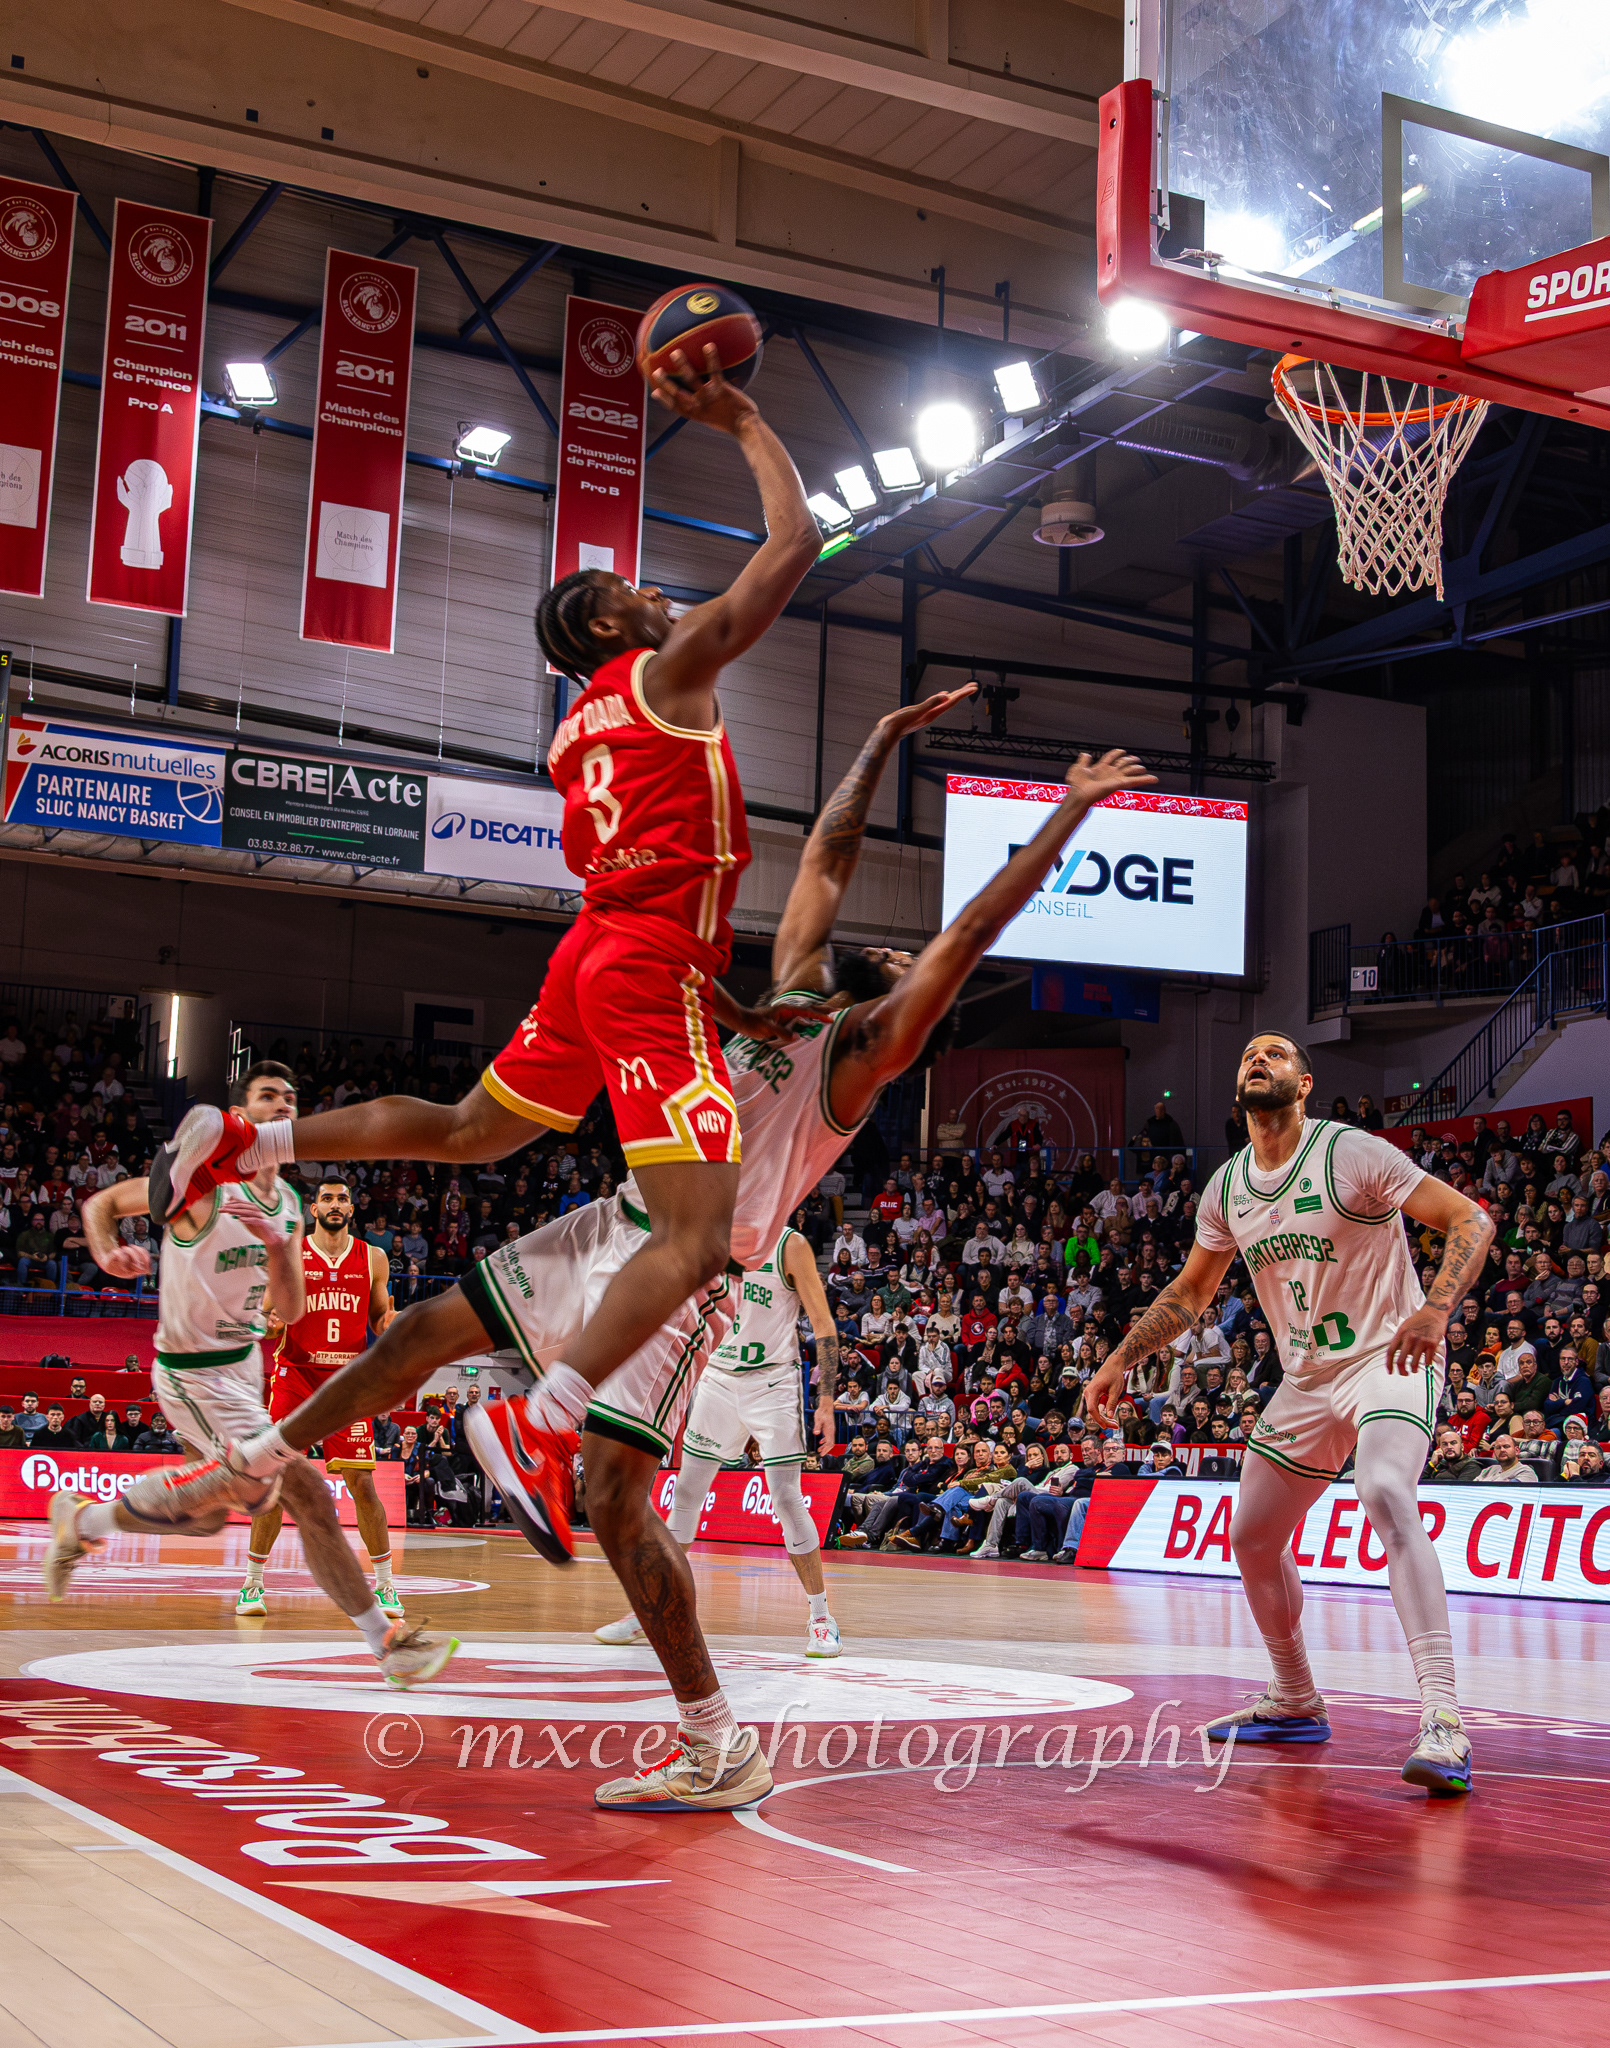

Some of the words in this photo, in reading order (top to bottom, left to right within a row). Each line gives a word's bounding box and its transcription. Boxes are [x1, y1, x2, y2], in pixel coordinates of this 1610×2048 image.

[125, 315, 187, 341] 2011
[24, 343, 54, 356] des
[113, 357, 193, 381] Champion
[335, 360, 395, 386] 2011
[113, 371, 133, 382] de
[136, 374, 192, 393] France
[128, 397, 159, 411] Pro
[161, 403, 173, 414] A
[325, 401, 370, 418] Match
[373, 411, 400, 424] des
[568, 402, 639, 430] 2022
[320, 413, 402, 437] Champions
[566, 456, 585, 466] de
[587, 459, 636, 476] France
[567, 443, 636, 465] Champion
[580, 481, 607, 494] Pro
[609, 486, 620, 496] B
[37, 773, 152, 806] PARTENAIRE
[36, 797, 73, 817] SLUC
[77, 802, 126, 824] NANCY
[130, 810, 186, 830] BASKET
[230, 806, 262, 821] CONSEIL
[264, 811, 274, 821] EN
[276, 812, 319, 827] IMMOBILIER
[320, 817, 371, 833] D'ENTREPRISE
[373, 825, 383, 835] EN
[384, 826, 420, 841] LORRAINE
[470, 818, 562, 851] DECATH
[248, 837, 314, 855] 03.83.32.86.77
[322, 848, 400, 866] www.cbre-acte.fr
[1008, 843, 1194, 905] YDGE
[1362, 969, 1377, 988] 10
[696, 1109, 727, 1134] NCY
[1243, 1232, 1339, 1277] NANTERRE92
[306, 1291, 361, 1314] NANCY
[1288, 1280, 1310, 1312] 12
[327, 1318, 340, 1343] 6
